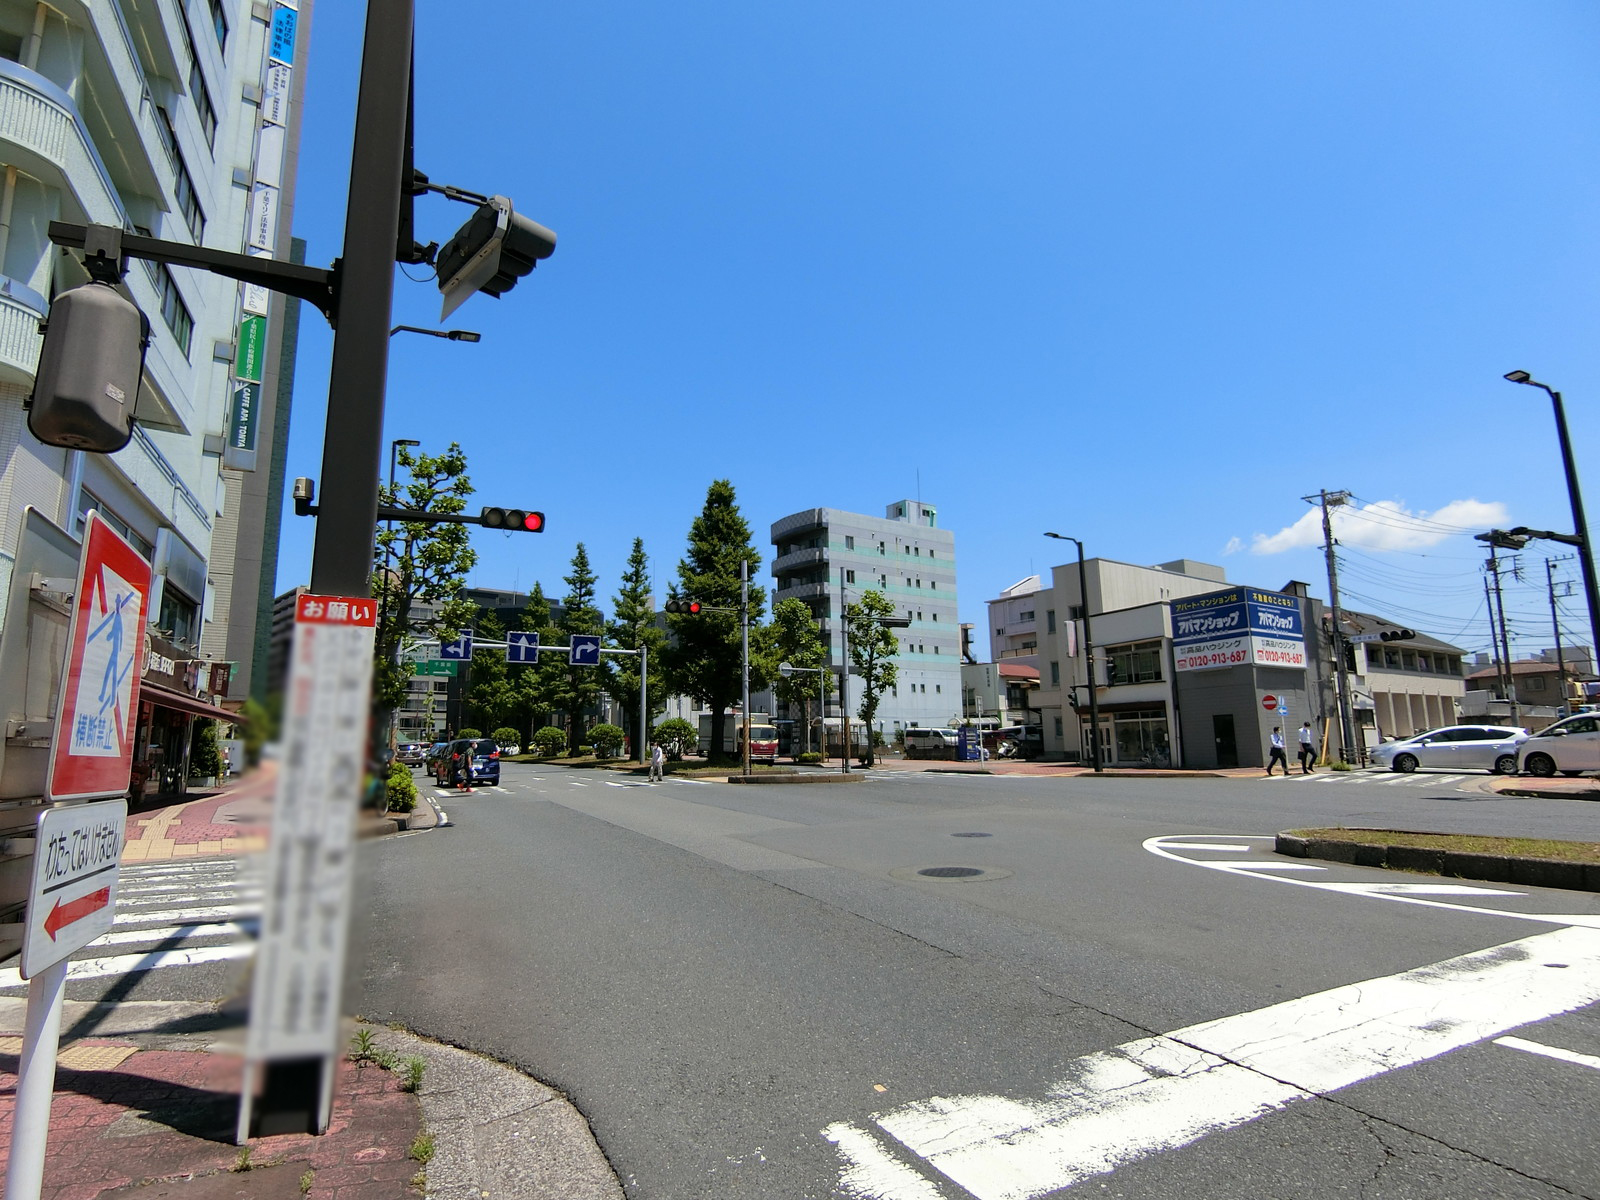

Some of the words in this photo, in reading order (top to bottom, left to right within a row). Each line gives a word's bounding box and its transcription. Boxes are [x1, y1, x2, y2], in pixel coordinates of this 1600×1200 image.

[273, 19, 284, 57] 法律事務所
[258, 191, 271, 246] 千葉マリン法律事務所
[303, 600, 370, 621] お願い
[1258, 612, 1293, 629] アパマンショップ
[1178, 611, 1240, 634] アパマンショップ
[1188, 650, 1247, 668] 0120-913-687
[1265, 650, 1302, 664] 0120-913-687
[76, 713, 114, 750] 横断禁止
[45, 820, 120, 882] わたってはいけません
